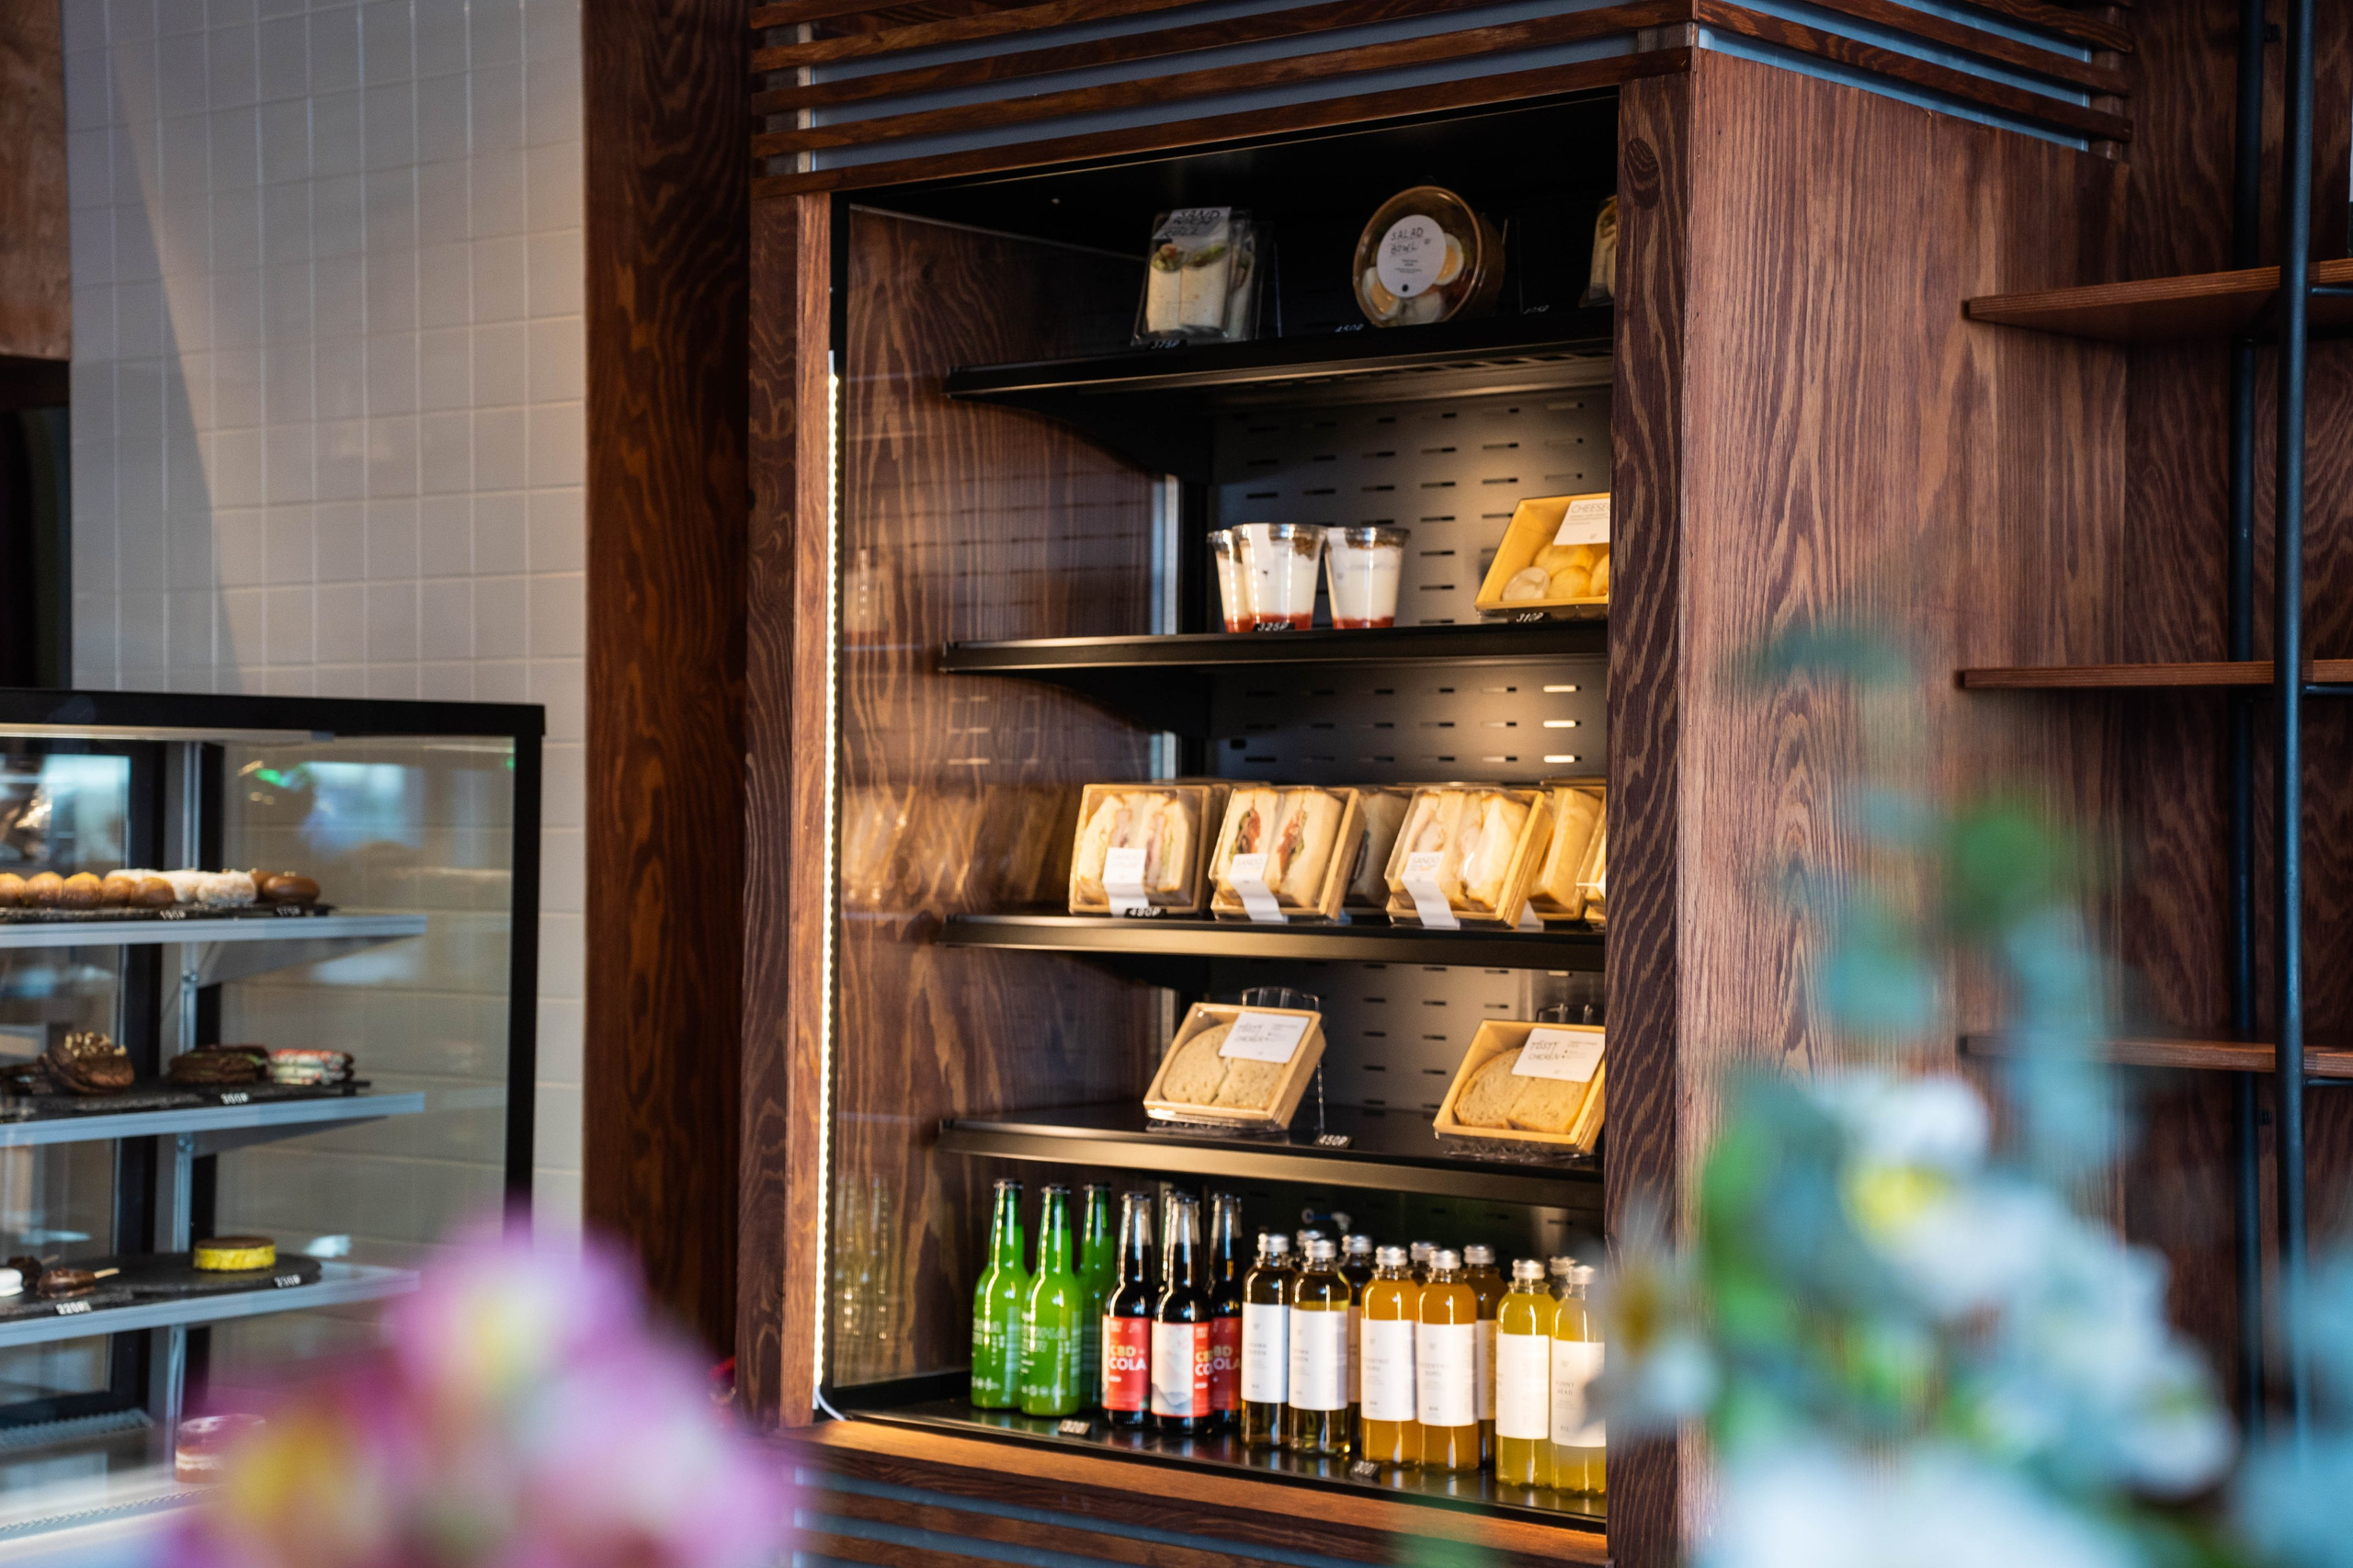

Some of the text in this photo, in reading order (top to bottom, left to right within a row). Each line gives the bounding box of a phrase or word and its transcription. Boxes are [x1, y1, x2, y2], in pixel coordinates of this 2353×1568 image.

[1390, 226, 1424, 241] SALAD
[1390, 242, 1417, 256] BOWL
[1108, 1345, 1137, 1358] CBD
[1108, 1357, 1147, 1371] COLA
